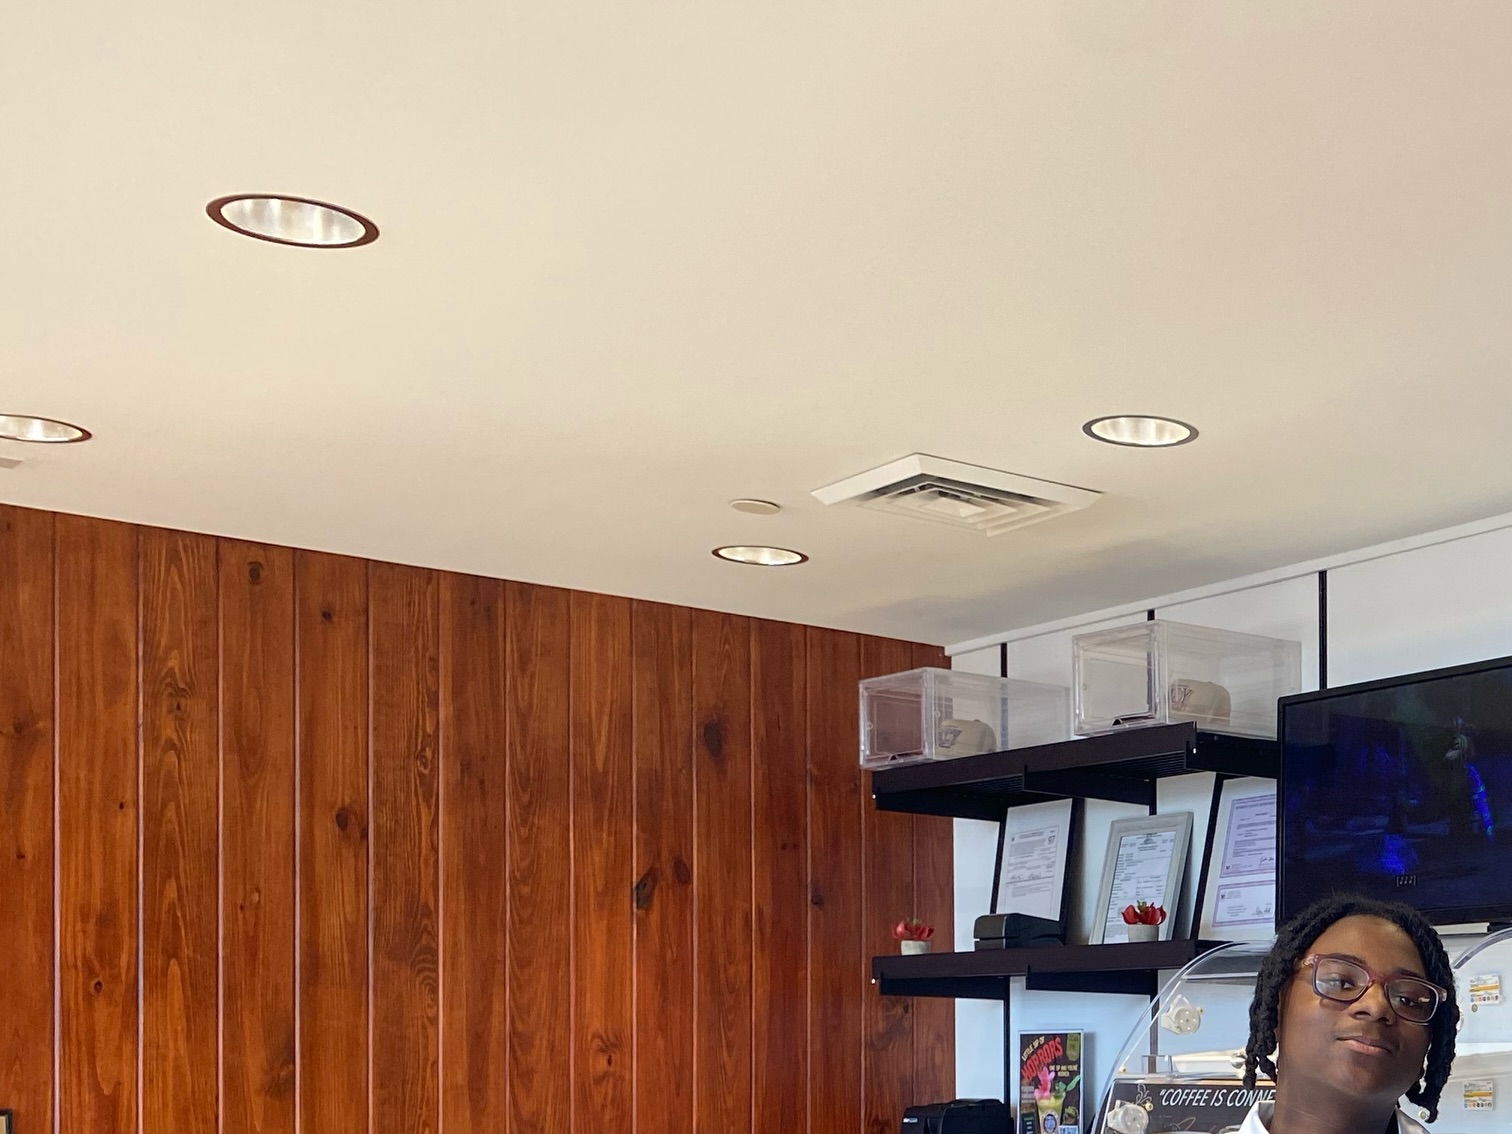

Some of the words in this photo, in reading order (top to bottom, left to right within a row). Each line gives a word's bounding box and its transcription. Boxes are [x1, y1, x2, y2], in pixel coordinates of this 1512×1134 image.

[1021, 1036, 1064, 1082] HORRORS
[1159, 1088, 1212, 1107] "COFFEE
[1212, 1088, 1228, 1107] IS
[1227, 1088, 1277, 1107] CONNE
